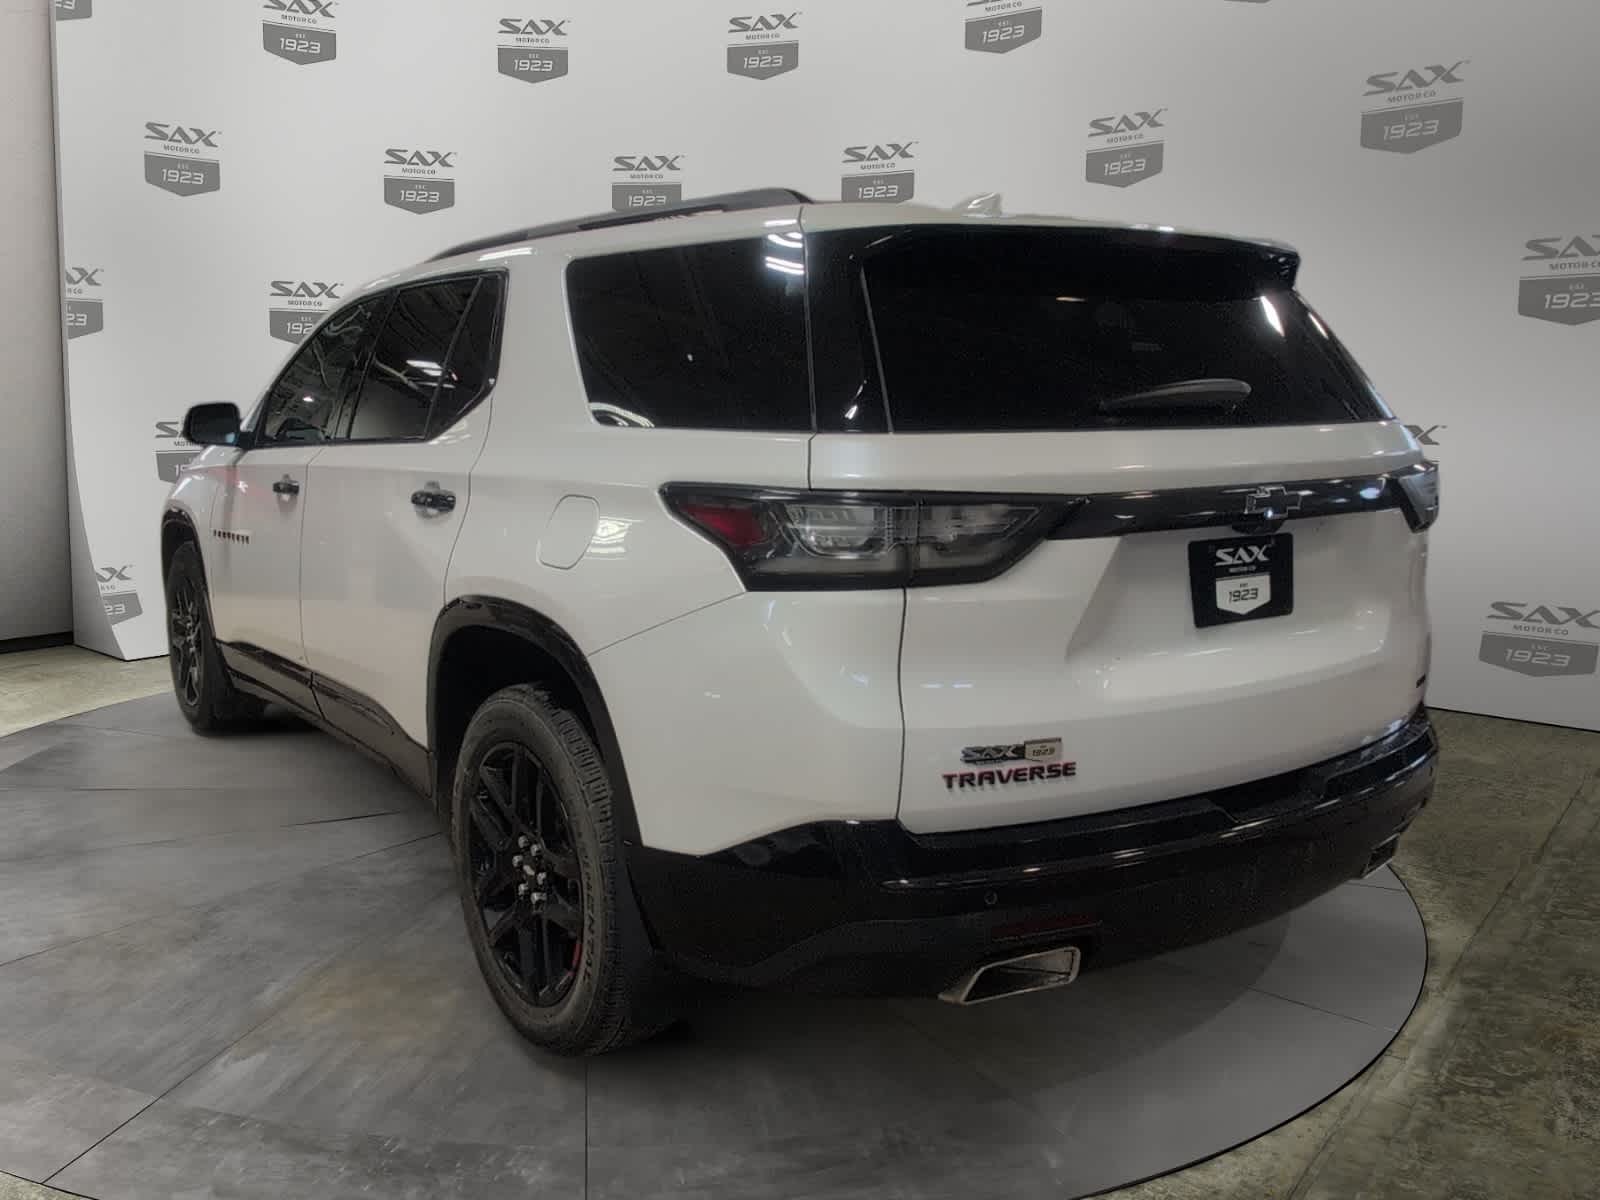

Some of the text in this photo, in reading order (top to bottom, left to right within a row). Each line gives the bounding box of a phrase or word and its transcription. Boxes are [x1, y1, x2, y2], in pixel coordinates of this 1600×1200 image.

[498, 18, 567, 36] SAX
[727, 12, 798, 33] SAX
[982, 24, 1025, 43] 1923
[279, 37, 321, 54] 1923
[513, 59, 553, 71] 1923
[743, 55, 783, 69] 1923
[1362, 61, 1465, 96] SAX
[1088, 108, 1165, 138] SAX
[1383, 119, 1440, 141] 1923
[144, 122, 218, 148] SAX
[384, 148, 454, 168] SAX
[841, 142, 914, 164] SAX
[612, 155, 681, 171] SAX
[1103, 158, 1146, 176] 1923
[161, 168, 204, 185] 1923
[400, 189, 440, 203] 1923
[628, 195, 667, 207] 1923
[857, 185, 899, 199] 1923
[1521, 235, 1600, 261] SA
[269, 280, 341, 299] SAX
[65, 313, 88, 327] 23
[286, 321, 313, 335] 192
[1215, 544, 1270, 567] SAX
[1228, 587, 1259, 604] 1923
[103, 602, 127, 616] 23
[1486, 601, 1600, 630] SAX
[1505, 648, 1570, 666] 1923
[942, 762, 1077, 790] TRAVERSE
